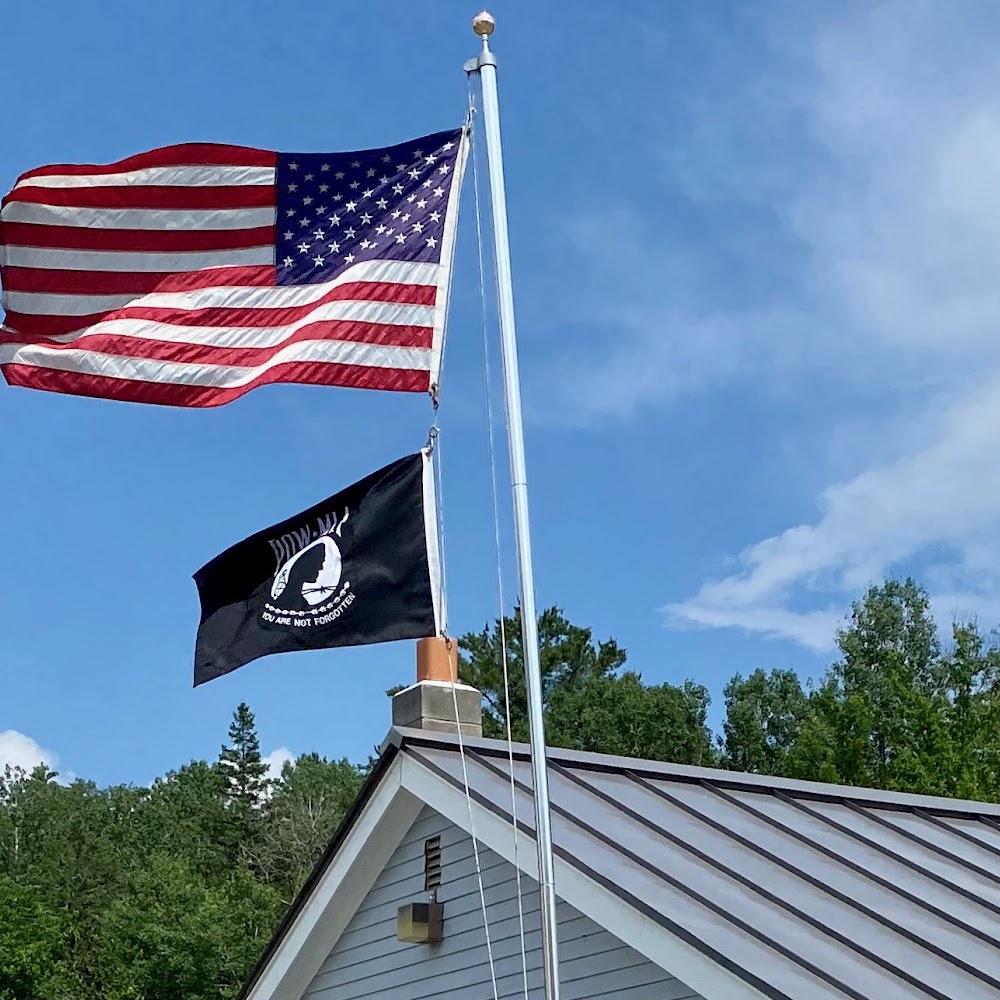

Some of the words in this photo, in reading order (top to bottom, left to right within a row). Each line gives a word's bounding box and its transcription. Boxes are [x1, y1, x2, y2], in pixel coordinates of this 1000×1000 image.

[261, 611, 275, 623] YOU
[275, 615, 292, 625] ARE
[294, 618, 312, 627] NOT
[314, 592, 356, 626] FORGOTTEN
